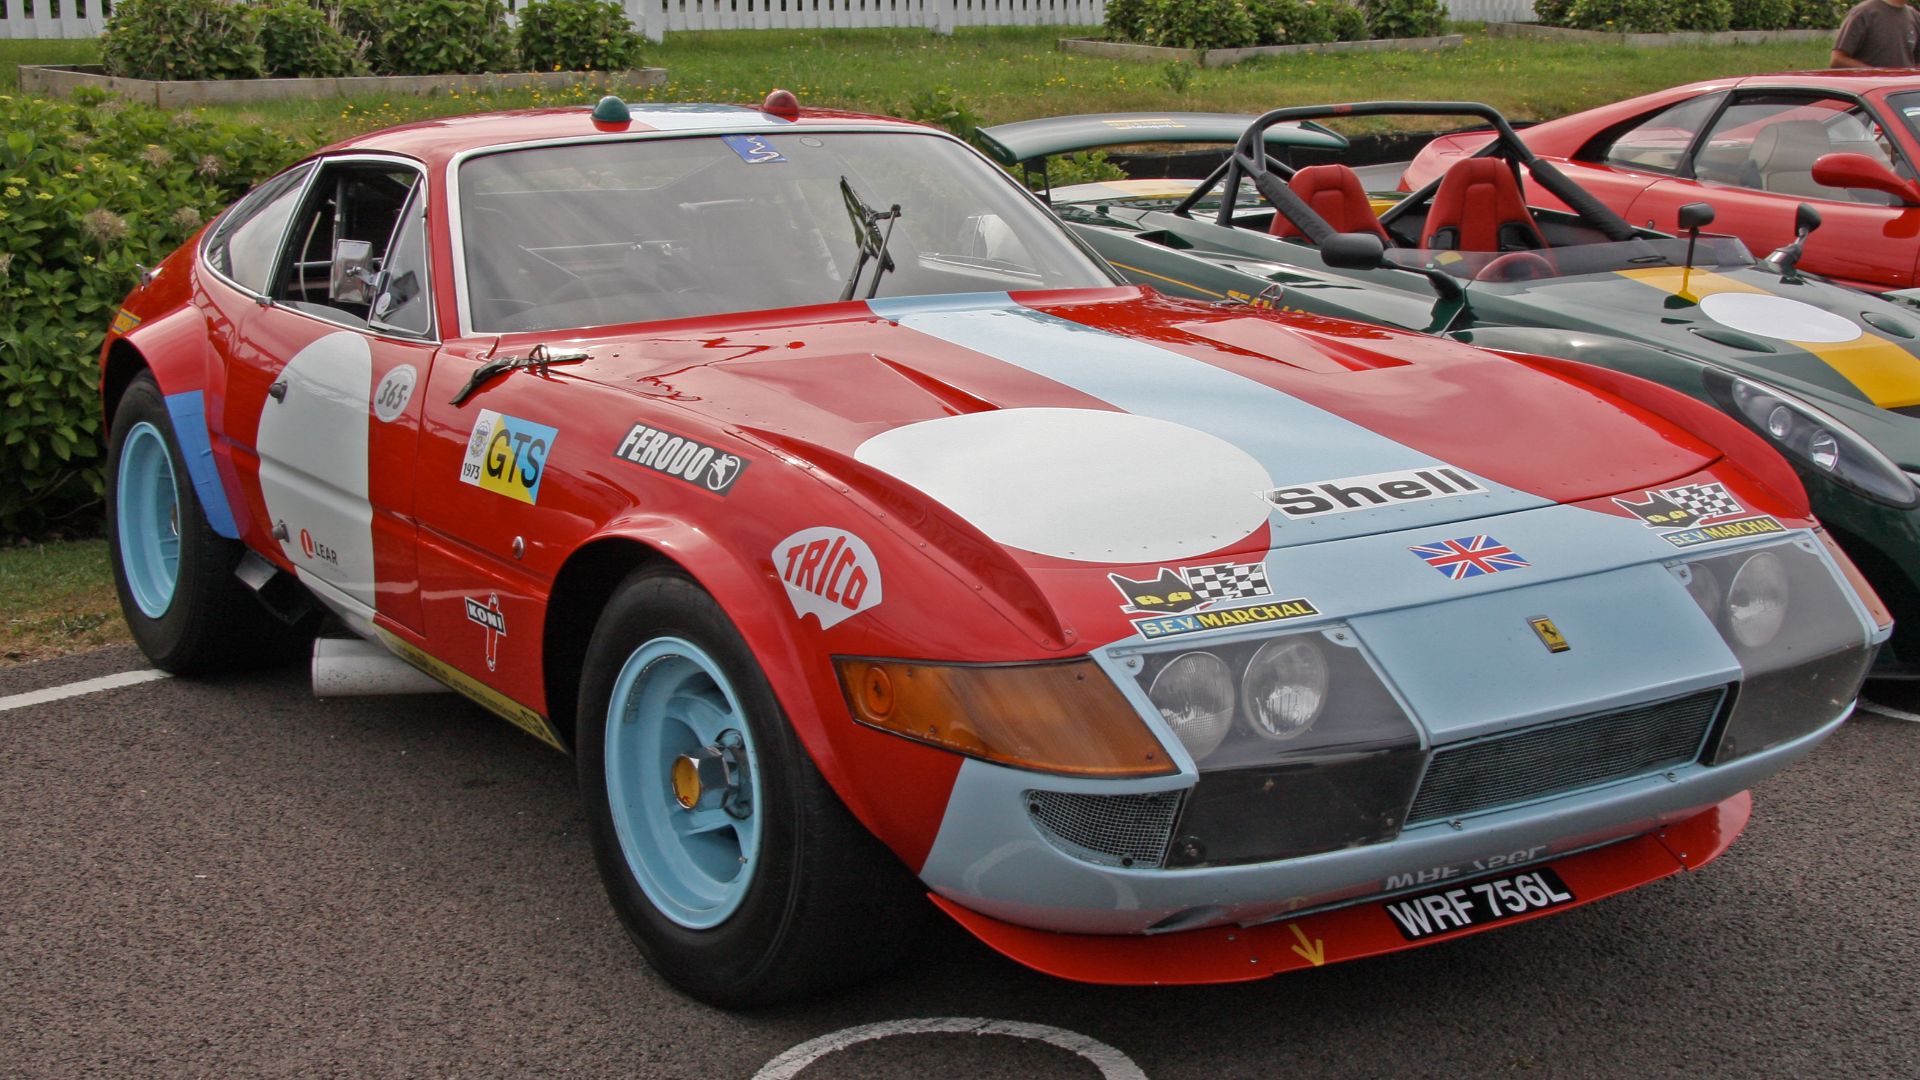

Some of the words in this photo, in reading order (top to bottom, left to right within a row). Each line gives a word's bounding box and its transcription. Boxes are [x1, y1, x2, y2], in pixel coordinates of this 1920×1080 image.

[462, 462, 480, 480] 1973
[486, 428, 546, 489] GTS
[616, 424, 715, 481] FERODO
[1273, 468, 1480, 515] Shell
[1702, 518, 1782, 539] MARCHAL
[314, 541, 338, 566] LEAR
[784, 535, 868, 611] TRICO
[468, 602, 503, 631] KONI
[1141, 615, 1199, 636] S.E.V.
[1196, 602, 1314, 628] MARCHAL
[1387, 889, 1475, 936] WRF
[1472, 872, 1571, 917] 756L
